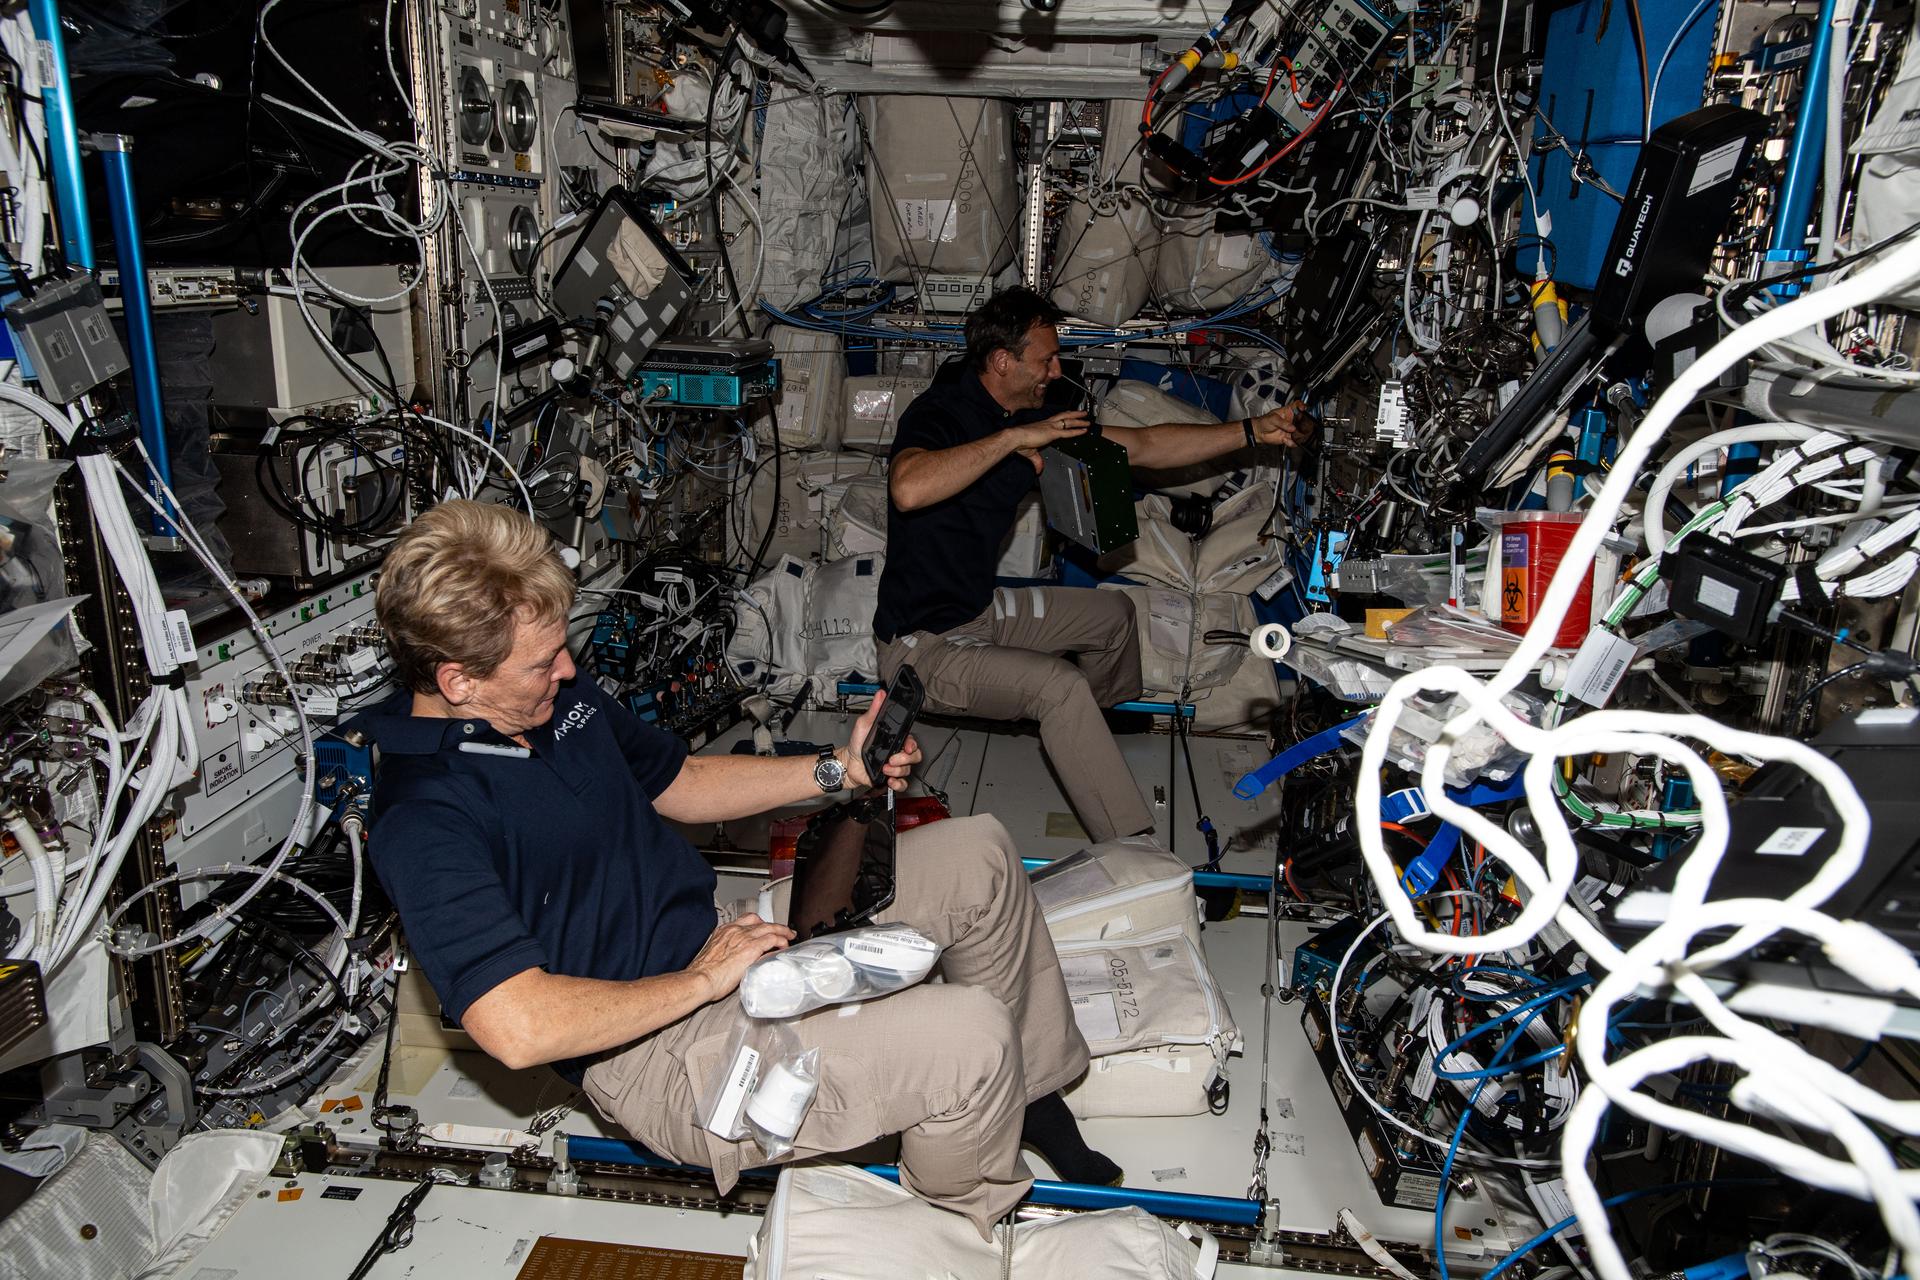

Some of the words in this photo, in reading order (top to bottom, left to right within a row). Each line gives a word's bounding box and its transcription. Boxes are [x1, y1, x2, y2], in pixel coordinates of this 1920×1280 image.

[1625, 195, 1654, 259] QUATECH
[302, 633, 322, 649] POWER
[554, 701, 589, 741] AXIOM
[576, 706, 597, 730] SPACE
[208, 767, 239, 790] INDICATION
[213, 763, 233, 779] SMOKE
[647, 1249, 668, 1258] Module
